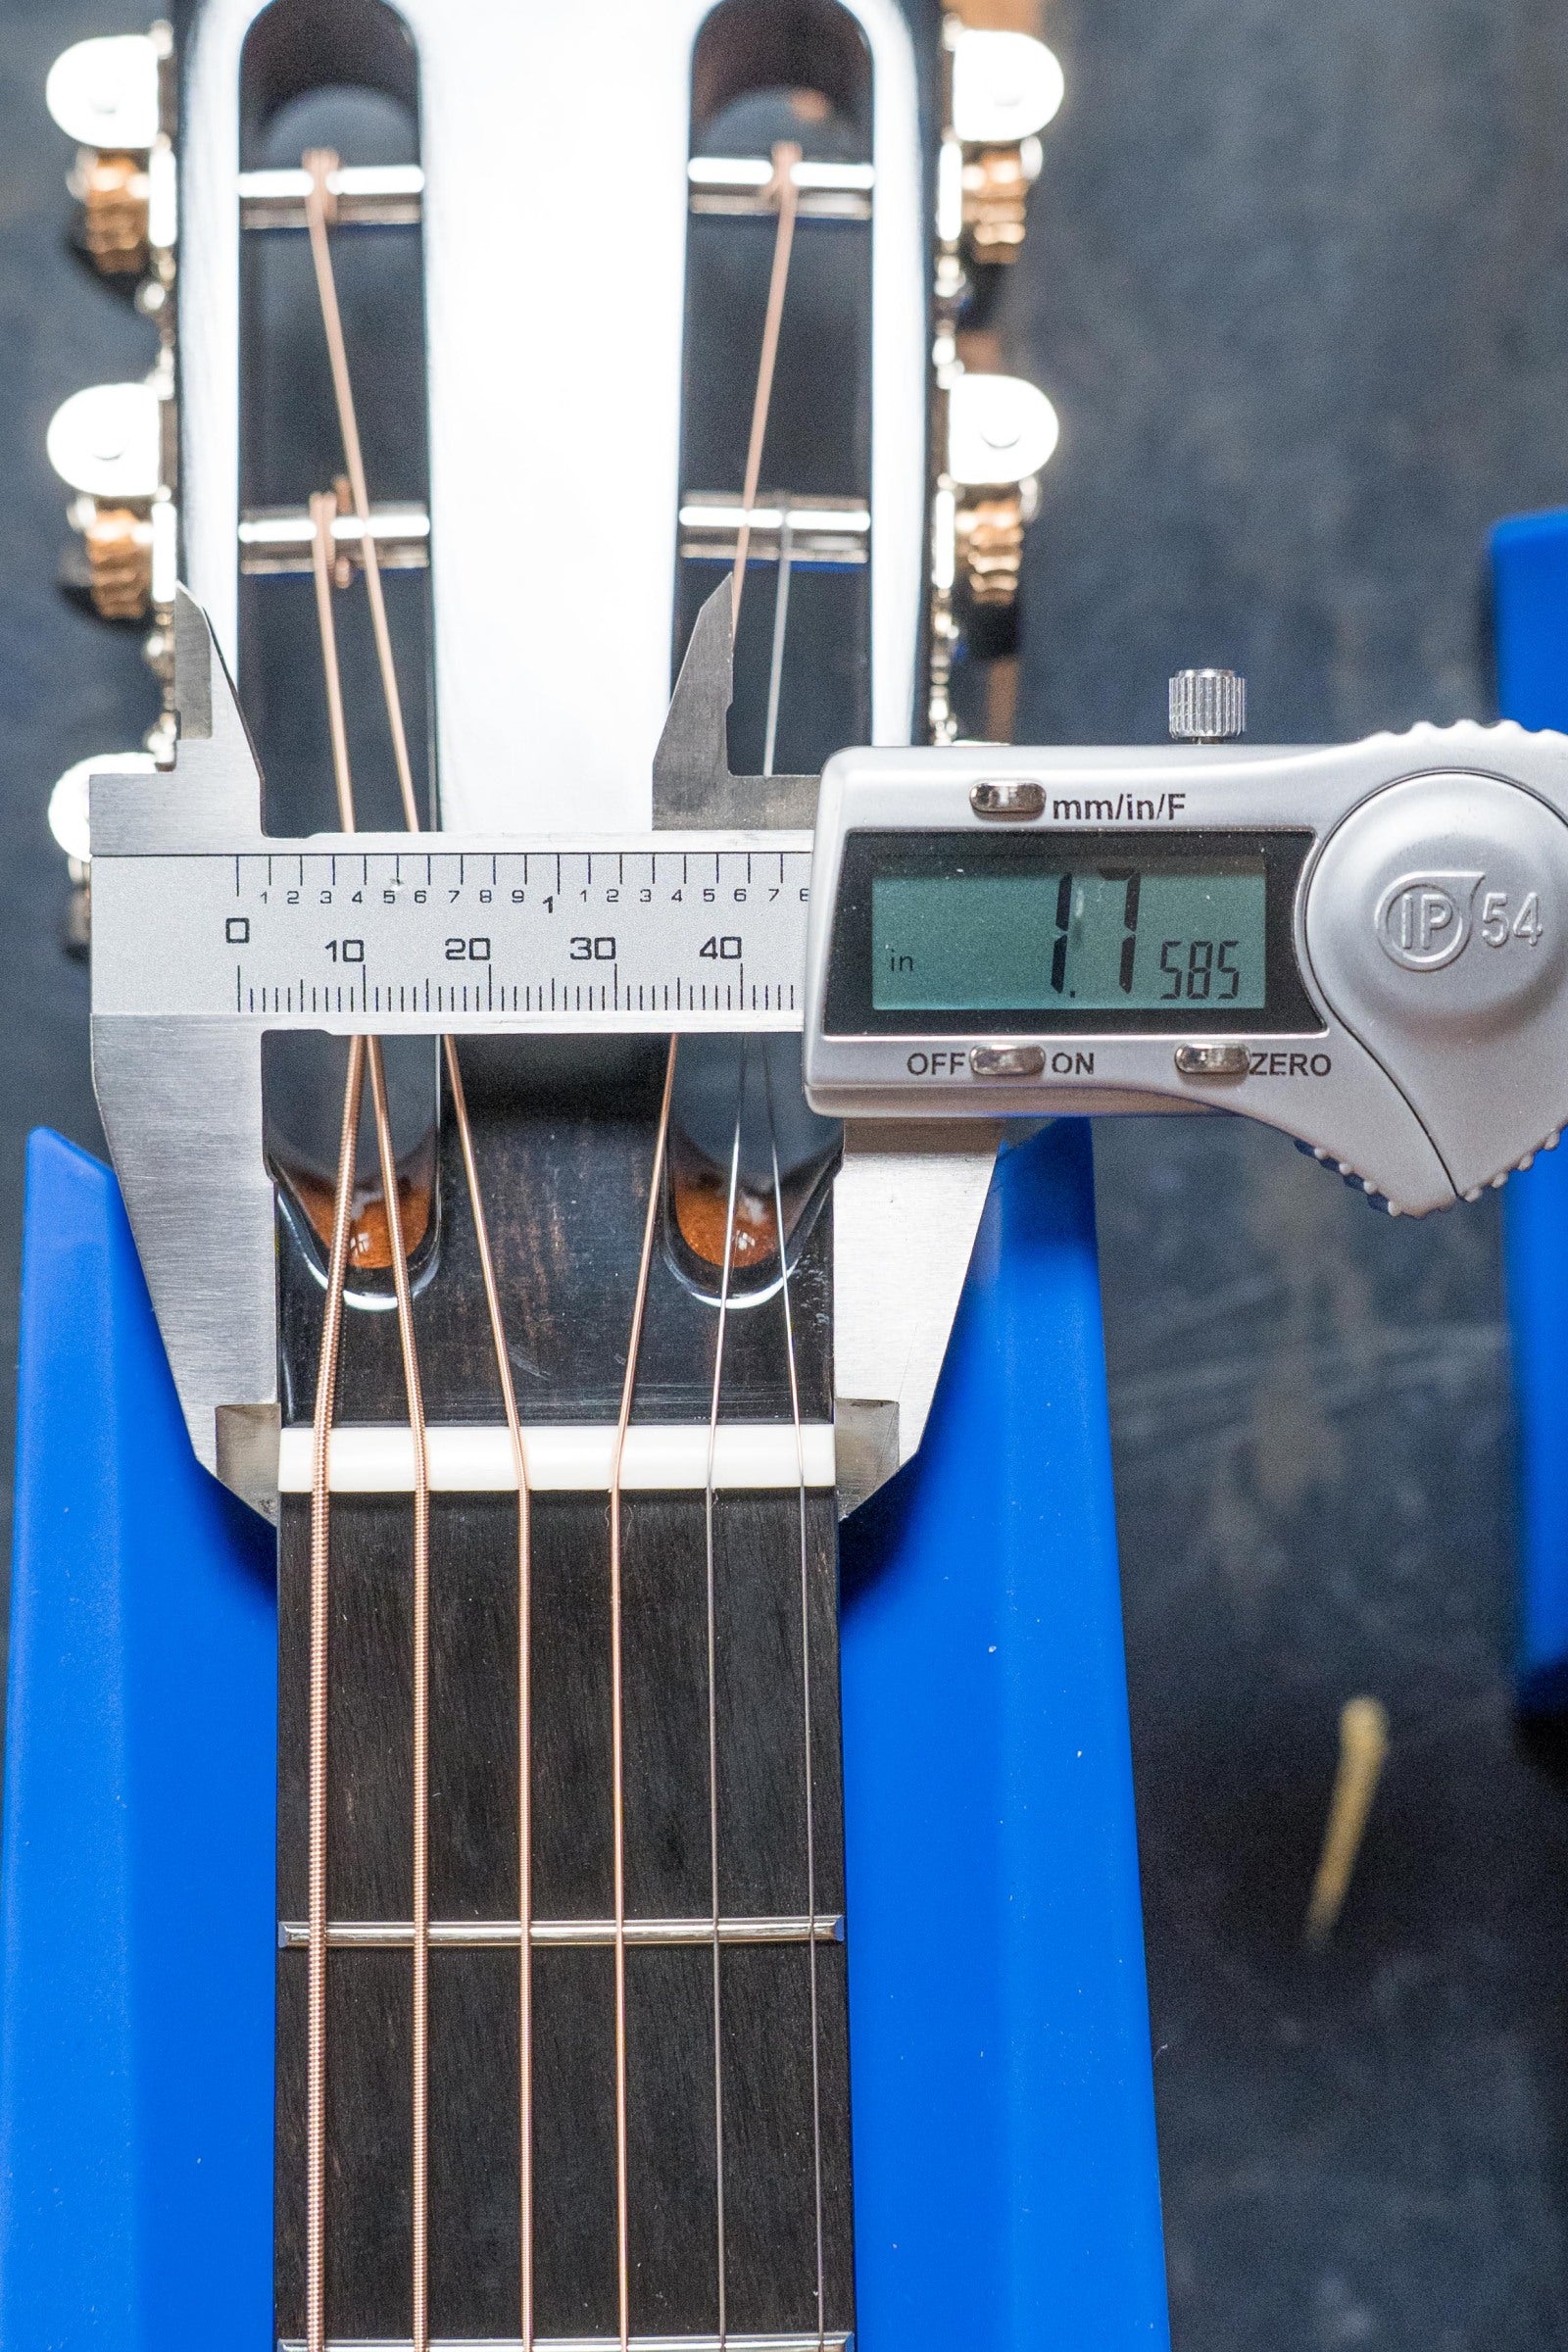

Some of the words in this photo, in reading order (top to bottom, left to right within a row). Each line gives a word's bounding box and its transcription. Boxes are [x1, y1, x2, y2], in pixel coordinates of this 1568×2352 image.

[1053, 792, 1186, 821] mm/in/F
[260, 890, 269, 905] 1
[286, 890, 300, 905] 2
[319, 890, 332, 905] 3
[351, 890, 364, 905] 4
[383, 890, 396, 905] 5
[414, 889, 427, 904] 6
[448, 889, 461, 904] 7
[479, 889, 493, 904] 8
[512, 889, 524, 904] 9
[542, 895, 555, 913] 1
[579, 889, 588, 903] 1
[606, 889, 619, 903] 2
[639, 889, 652, 903] 3
[670, 889, 683, 903] 4
[703, 889, 715, 903] 5
[733, 889, 747, 903] 6
[767, 889, 780, 903] 7
[1398, 892, 1452, 951] IP
[1481, 891, 1544, 949] 54
[225, 917, 250, 944] 0
[324, 939, 365, 962] 10
[444, 937, 491, 960] 20
[569, 936, 616, 960] 30
[699, 935, 742, 960] 40
[889, 950, 914, 972] in
[906, 1052, 967, 1077] OFF
[1052, 1052, 1096, 1076] ON
[1249, 1052, 1332, 1077] ZERO
